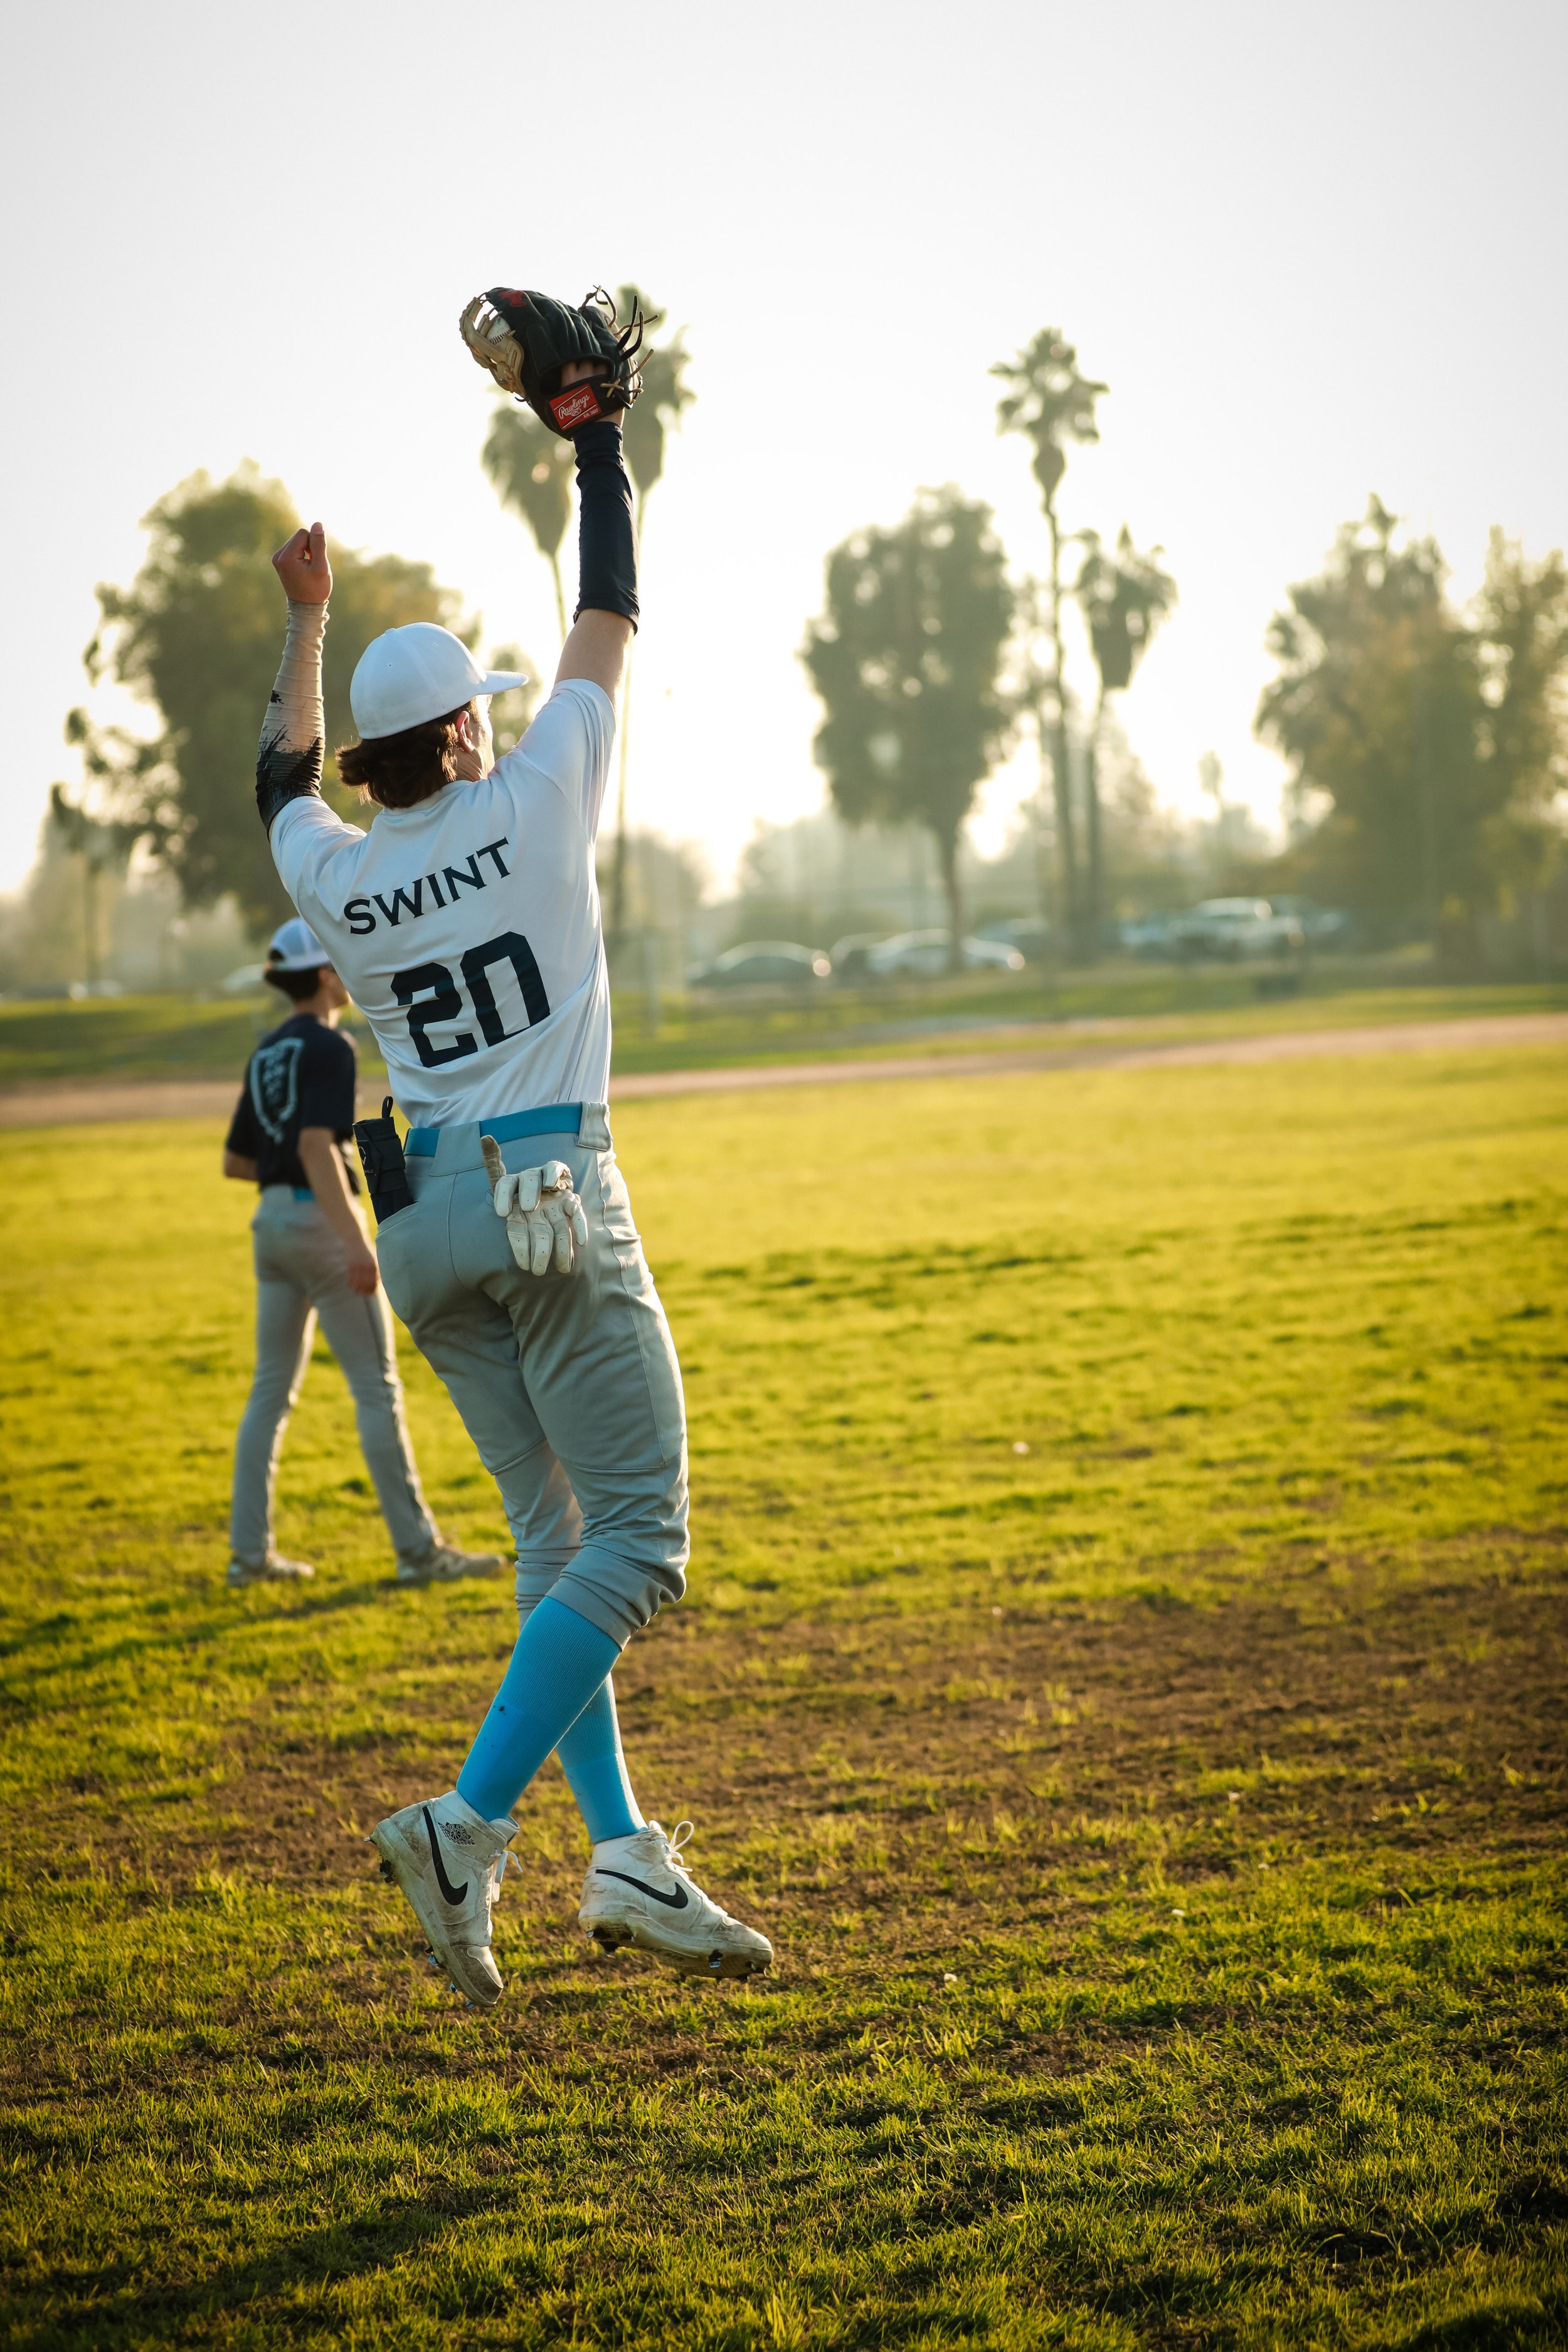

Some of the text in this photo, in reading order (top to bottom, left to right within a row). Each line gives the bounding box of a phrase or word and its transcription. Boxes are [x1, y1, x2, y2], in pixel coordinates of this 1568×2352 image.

[558, 395, 590, 419] Rawlings
[344, 837, 511, 935] SWINT
[391, 931, 551, 1067] 20
